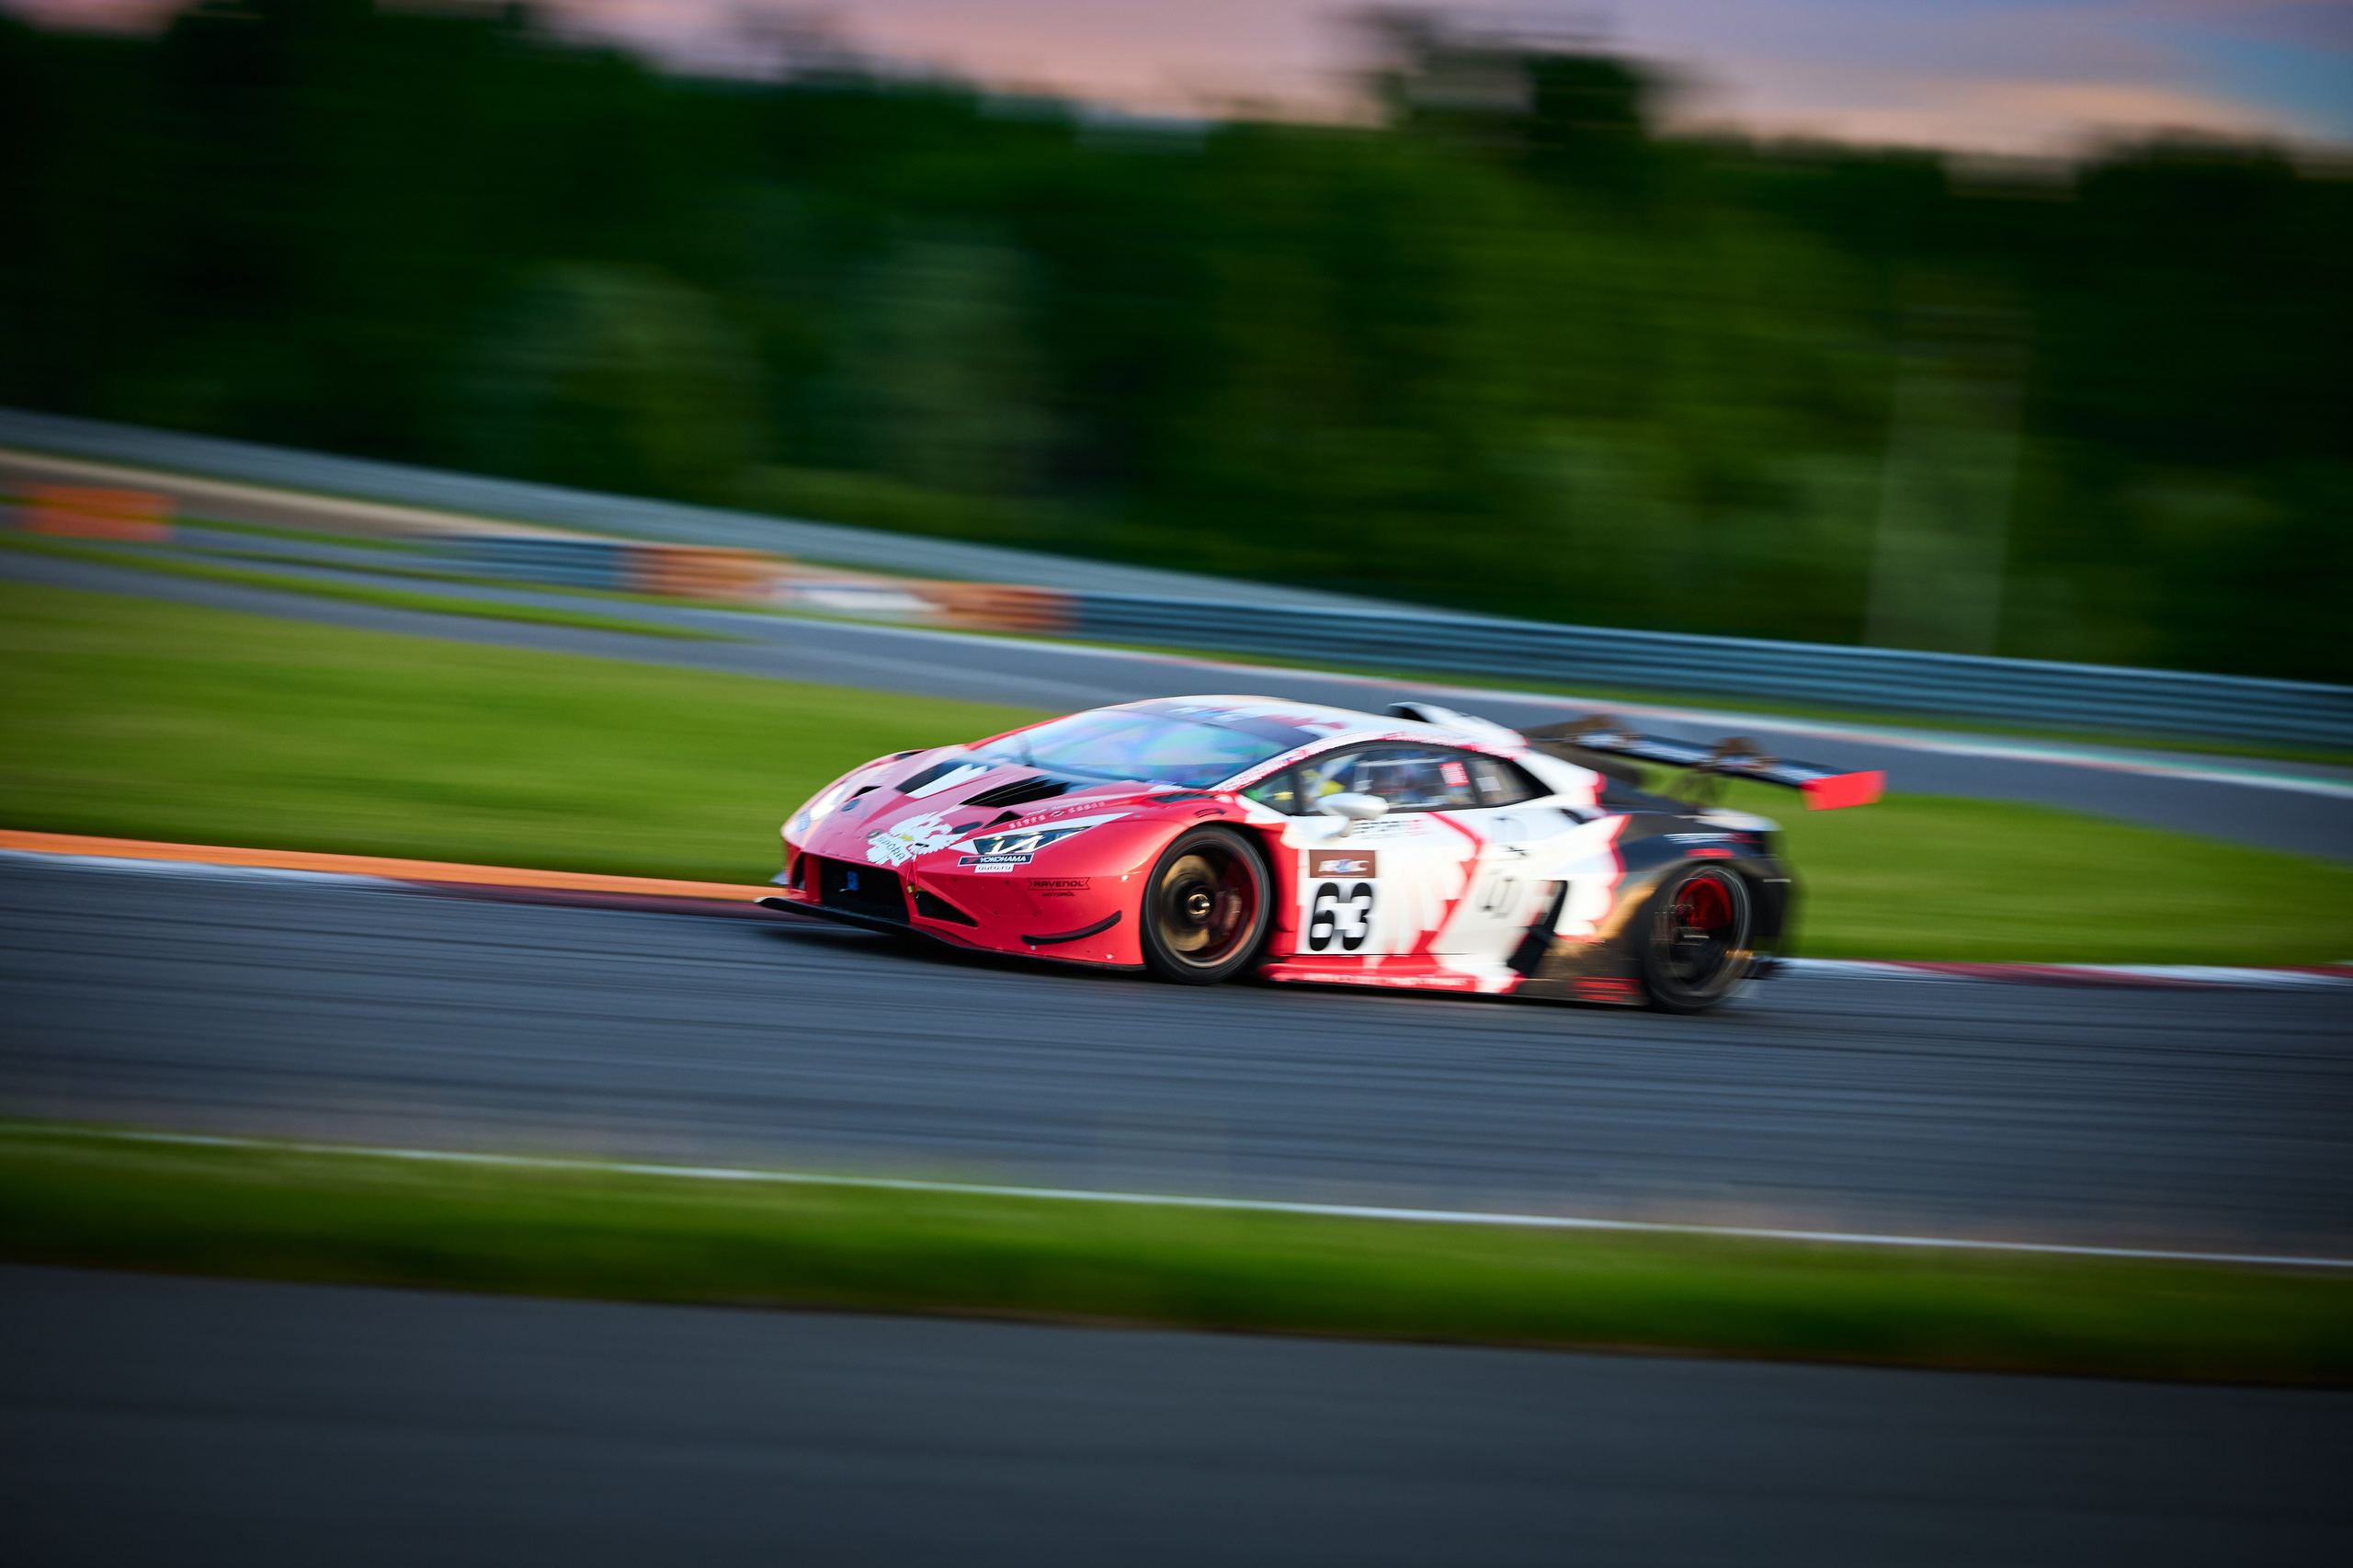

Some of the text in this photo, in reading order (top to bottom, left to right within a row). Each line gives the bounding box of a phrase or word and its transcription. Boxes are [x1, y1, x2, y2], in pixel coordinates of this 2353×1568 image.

[979, 855, 1027, 863] YOKOHAMA
[1032, 880, 1084, 888] RAVENOL
[1309, 881, 1374, 952] 63
